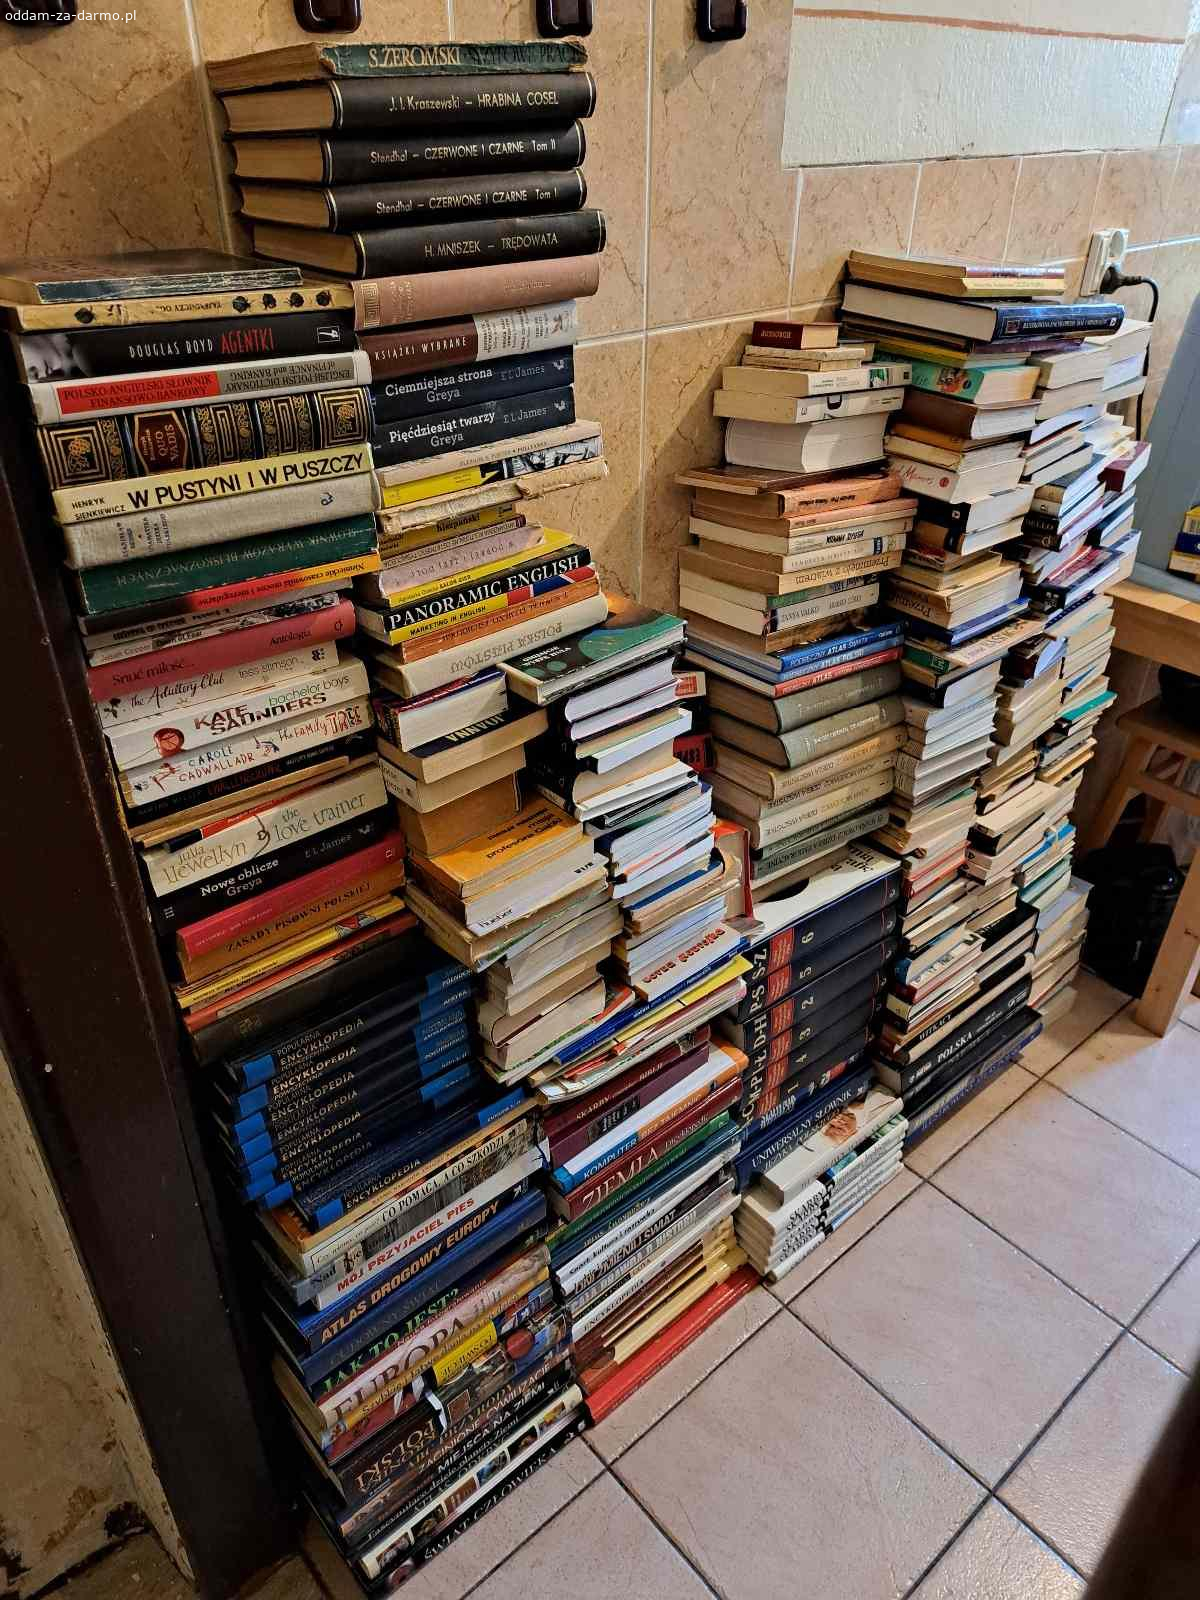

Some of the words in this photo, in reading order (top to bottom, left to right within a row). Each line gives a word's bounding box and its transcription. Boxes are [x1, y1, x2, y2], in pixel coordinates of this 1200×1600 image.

[407, 95, 460, 112] Kraszewski
[477, 92, 522, 108] HRABINA
[527, 91, 559, 106] COSEL
[370, 149, 408, 164] Stendhal
[424, 144, 478, 160] CZERWONE
[488, 141, 525, 155] CZARNE
[531, 140, 548, 152] Tom
[376, 200, 413, 214] Stendhal
[428, 194, 483, 210] CZERWONE
[492, 190, 528, 205] CZARNE
[535, 188, 551, 200] Tom
[424, 243, 435, 257] H.
[437, 240, 481, 257] MNISZEK
[501, 232, 559, 250] TRĘDOWATA
[129, 340, 180, 358] DOUGLAS
[186, 337, 214, 354] BOYD
[220, 327, 275, 354] AGENTKI
[374, 344, 416, 361] KSIĄŻKI
[421, 336, 468, 354] WYBRANE
[385, 374, 456, 399] Ciemniejsza
[457, 367, 493, 385] strona
[426, 388, 461, 403] Greya
[389, 418, 457, 443] Pięćdziesiąt
[458, 412, 496, 431] twarzy
[430, 433, 464, 448] Greya
[128, 490, 149, 510] W
[155, 473, 241, 503] PUSTYNI
[249, 470, 254, 487] I
[258, 467, 278, 486] W
[283, 453, 364, 480] PUSZCZY
[72, 497, 105, 510] HENRYK
[75, 503, 127, 522] SIENKIEWICZ
[389, 580, 503, 630] PANORAMIC
[507, 554, 579, 591] ENGLISH
[409, 615, 450, 637] MARKETING
[460, 604, 487, 623] ENGLISH
[269, 628, 312, 647] Antologia
[268, 684, 321, 706] bachelor
[323, 674, 350, 693] boys
[194, 704, 248, 730] KATE
[211, 693, 327, 736] SAUNDERS
[447, 714, 506, 744] JOANNA
[178, 752, 256, 783] CADWALLADR
[188, 743, 234, 767] CAROLE
[273, 820, 311, 842] love
[313, 792, 367, 825] trainer
[281, 806, 300, 823] the
[200, 875, 235, 897] Nowe
[237, 857, 280, 883] oblicze
[226, 877, 264, 897] Greya
[225, 926, 272, 953] ZASADY
[801, 931, 814, 944] 6
[800, 966, 813, 979] 5
[801, 995, 814, 1010] 2
[279, 1018, 365, 1065] ENCYKLOPEDIA
[935, 1031, 975, 1064] POLSKA
[272, 1046, 358, 1095] ENCYKLOPEDIA
[271, 1071, 356, 1122] ENCYKLOPEDIA
[276, 1090, 360, 1142] ENCYKLOPEDIA
[281, 1110, 362, 1162] ENCYKLOPEDIA
[583, 1137, 639, 1179] KOMPUTER
[346, 1159, 421, 1211] ENCYKLOPEDIA
[582, 1147, 659, 1210] ZIEMIA
[337, 1268, 364, 1293] MÓJ
[367, 1217, 446, 1272] PRZYJACIEL
[446, 1197, 475, 1220] PIES
[319, 1300, 369, 1345] ATLAS
[371, 1241, 444, 1305] DROGOWY
[445, 1200, 500, 1249] EUROPY
[322, 1359, 365, 1393] JAK
[368, 1330, 400, 1360] TO
[417, 1420, 483, 1473] ZAGINIONE
[485, 1363, 553, 1419] CYWILIZACJE
[436, 1425, 494, 1474] MIEJSCA
[493, 1408, 514, 1430] NA
[513, 1382, 547, 1410] ZIEMI
[423, 1521, 471, 1561] ŚWIAT
